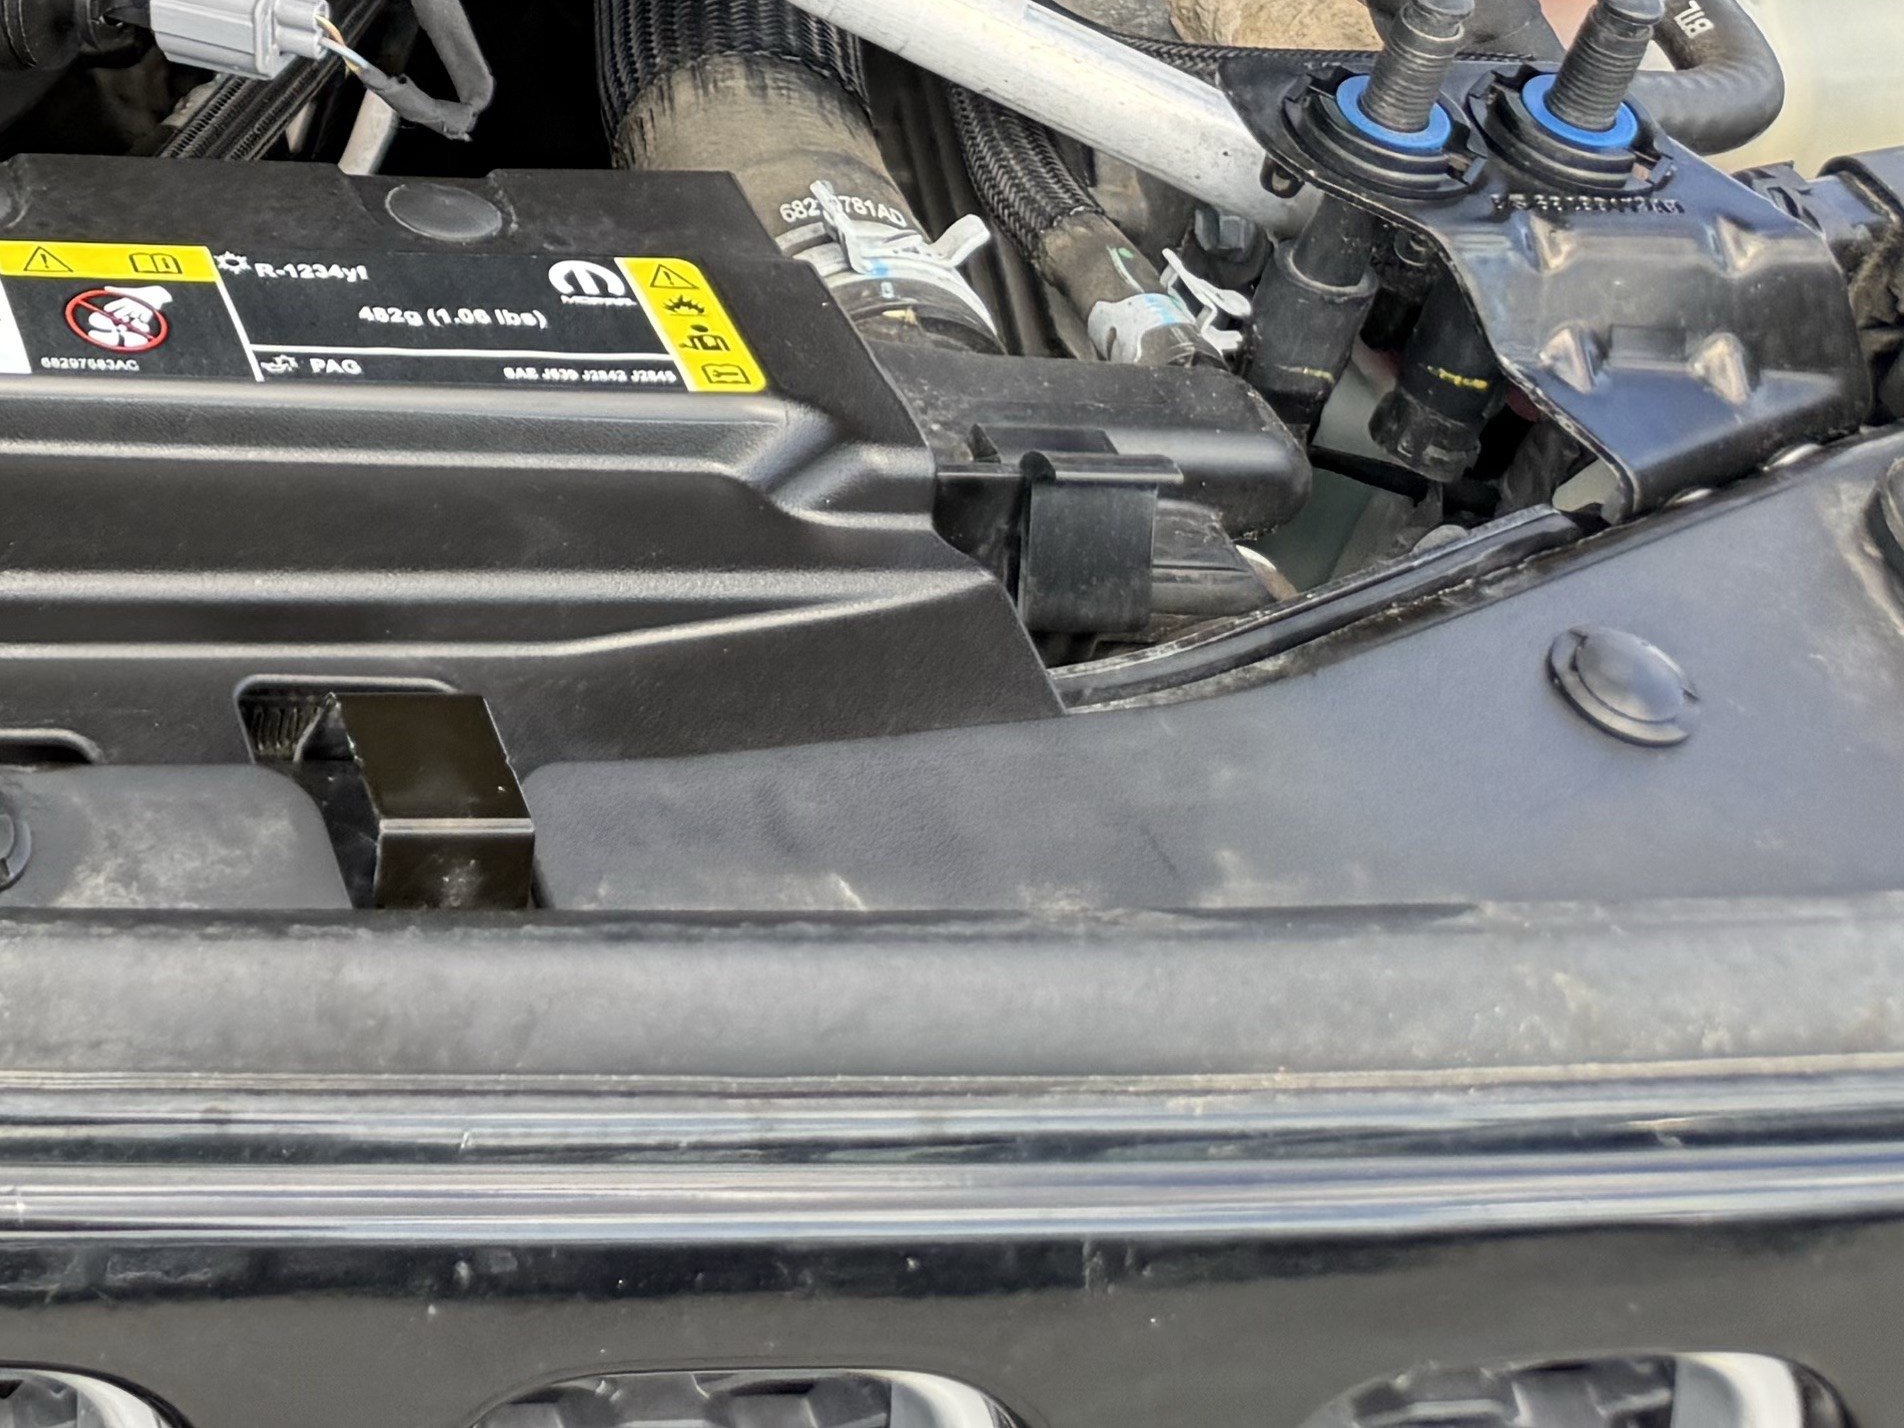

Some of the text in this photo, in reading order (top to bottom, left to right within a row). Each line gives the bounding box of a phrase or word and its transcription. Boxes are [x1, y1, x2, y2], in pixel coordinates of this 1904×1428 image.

[779, 195, 907, 228] 682781AD
[496, 308, 548, 330] lbs)
[309, 358, 364, 376] PAG
